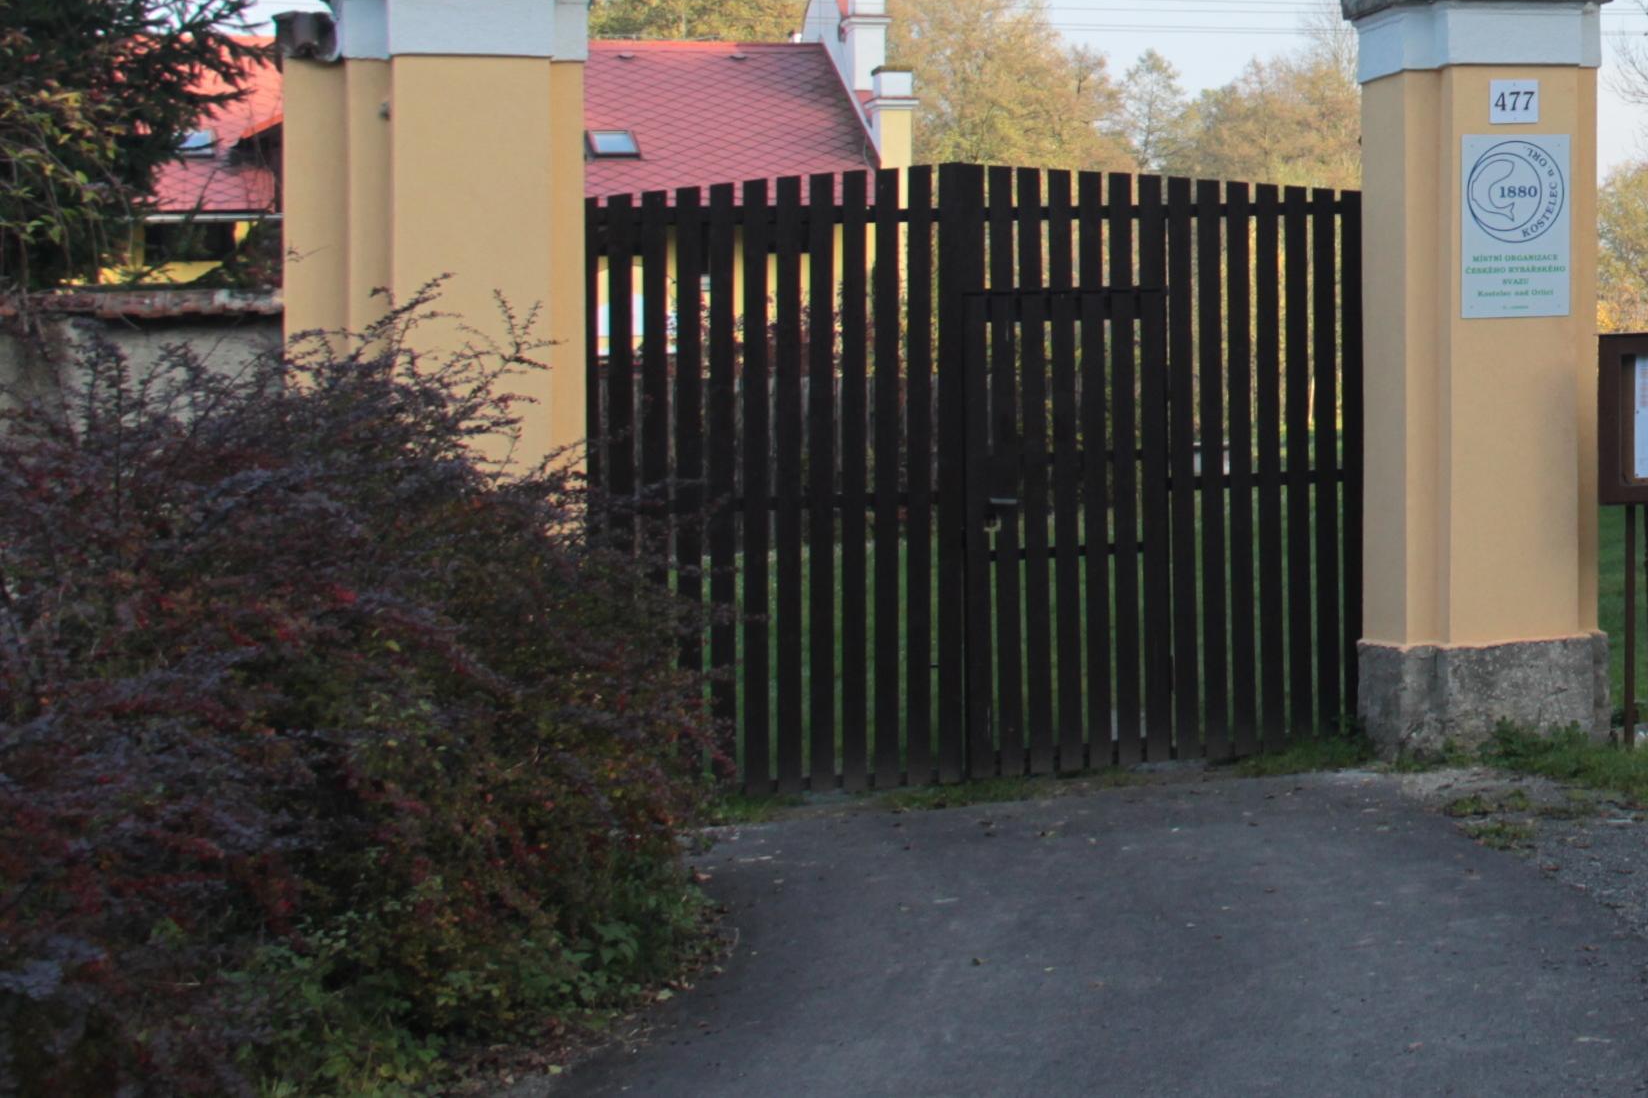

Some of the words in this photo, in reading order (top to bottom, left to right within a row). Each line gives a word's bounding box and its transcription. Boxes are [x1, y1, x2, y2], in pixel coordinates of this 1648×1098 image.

[1494, 91, 1535, 111] 477
[1499, 185, 1538, 199] 1880
[1521, 181, 1558, 238] KOSTELEC
[1472, 254, 1503, 262] MÍSTNÍ
[1504, 254, 1559, 262] ORGANIZACE
[1465, 266, 1506, 274] ČESKÉHO
